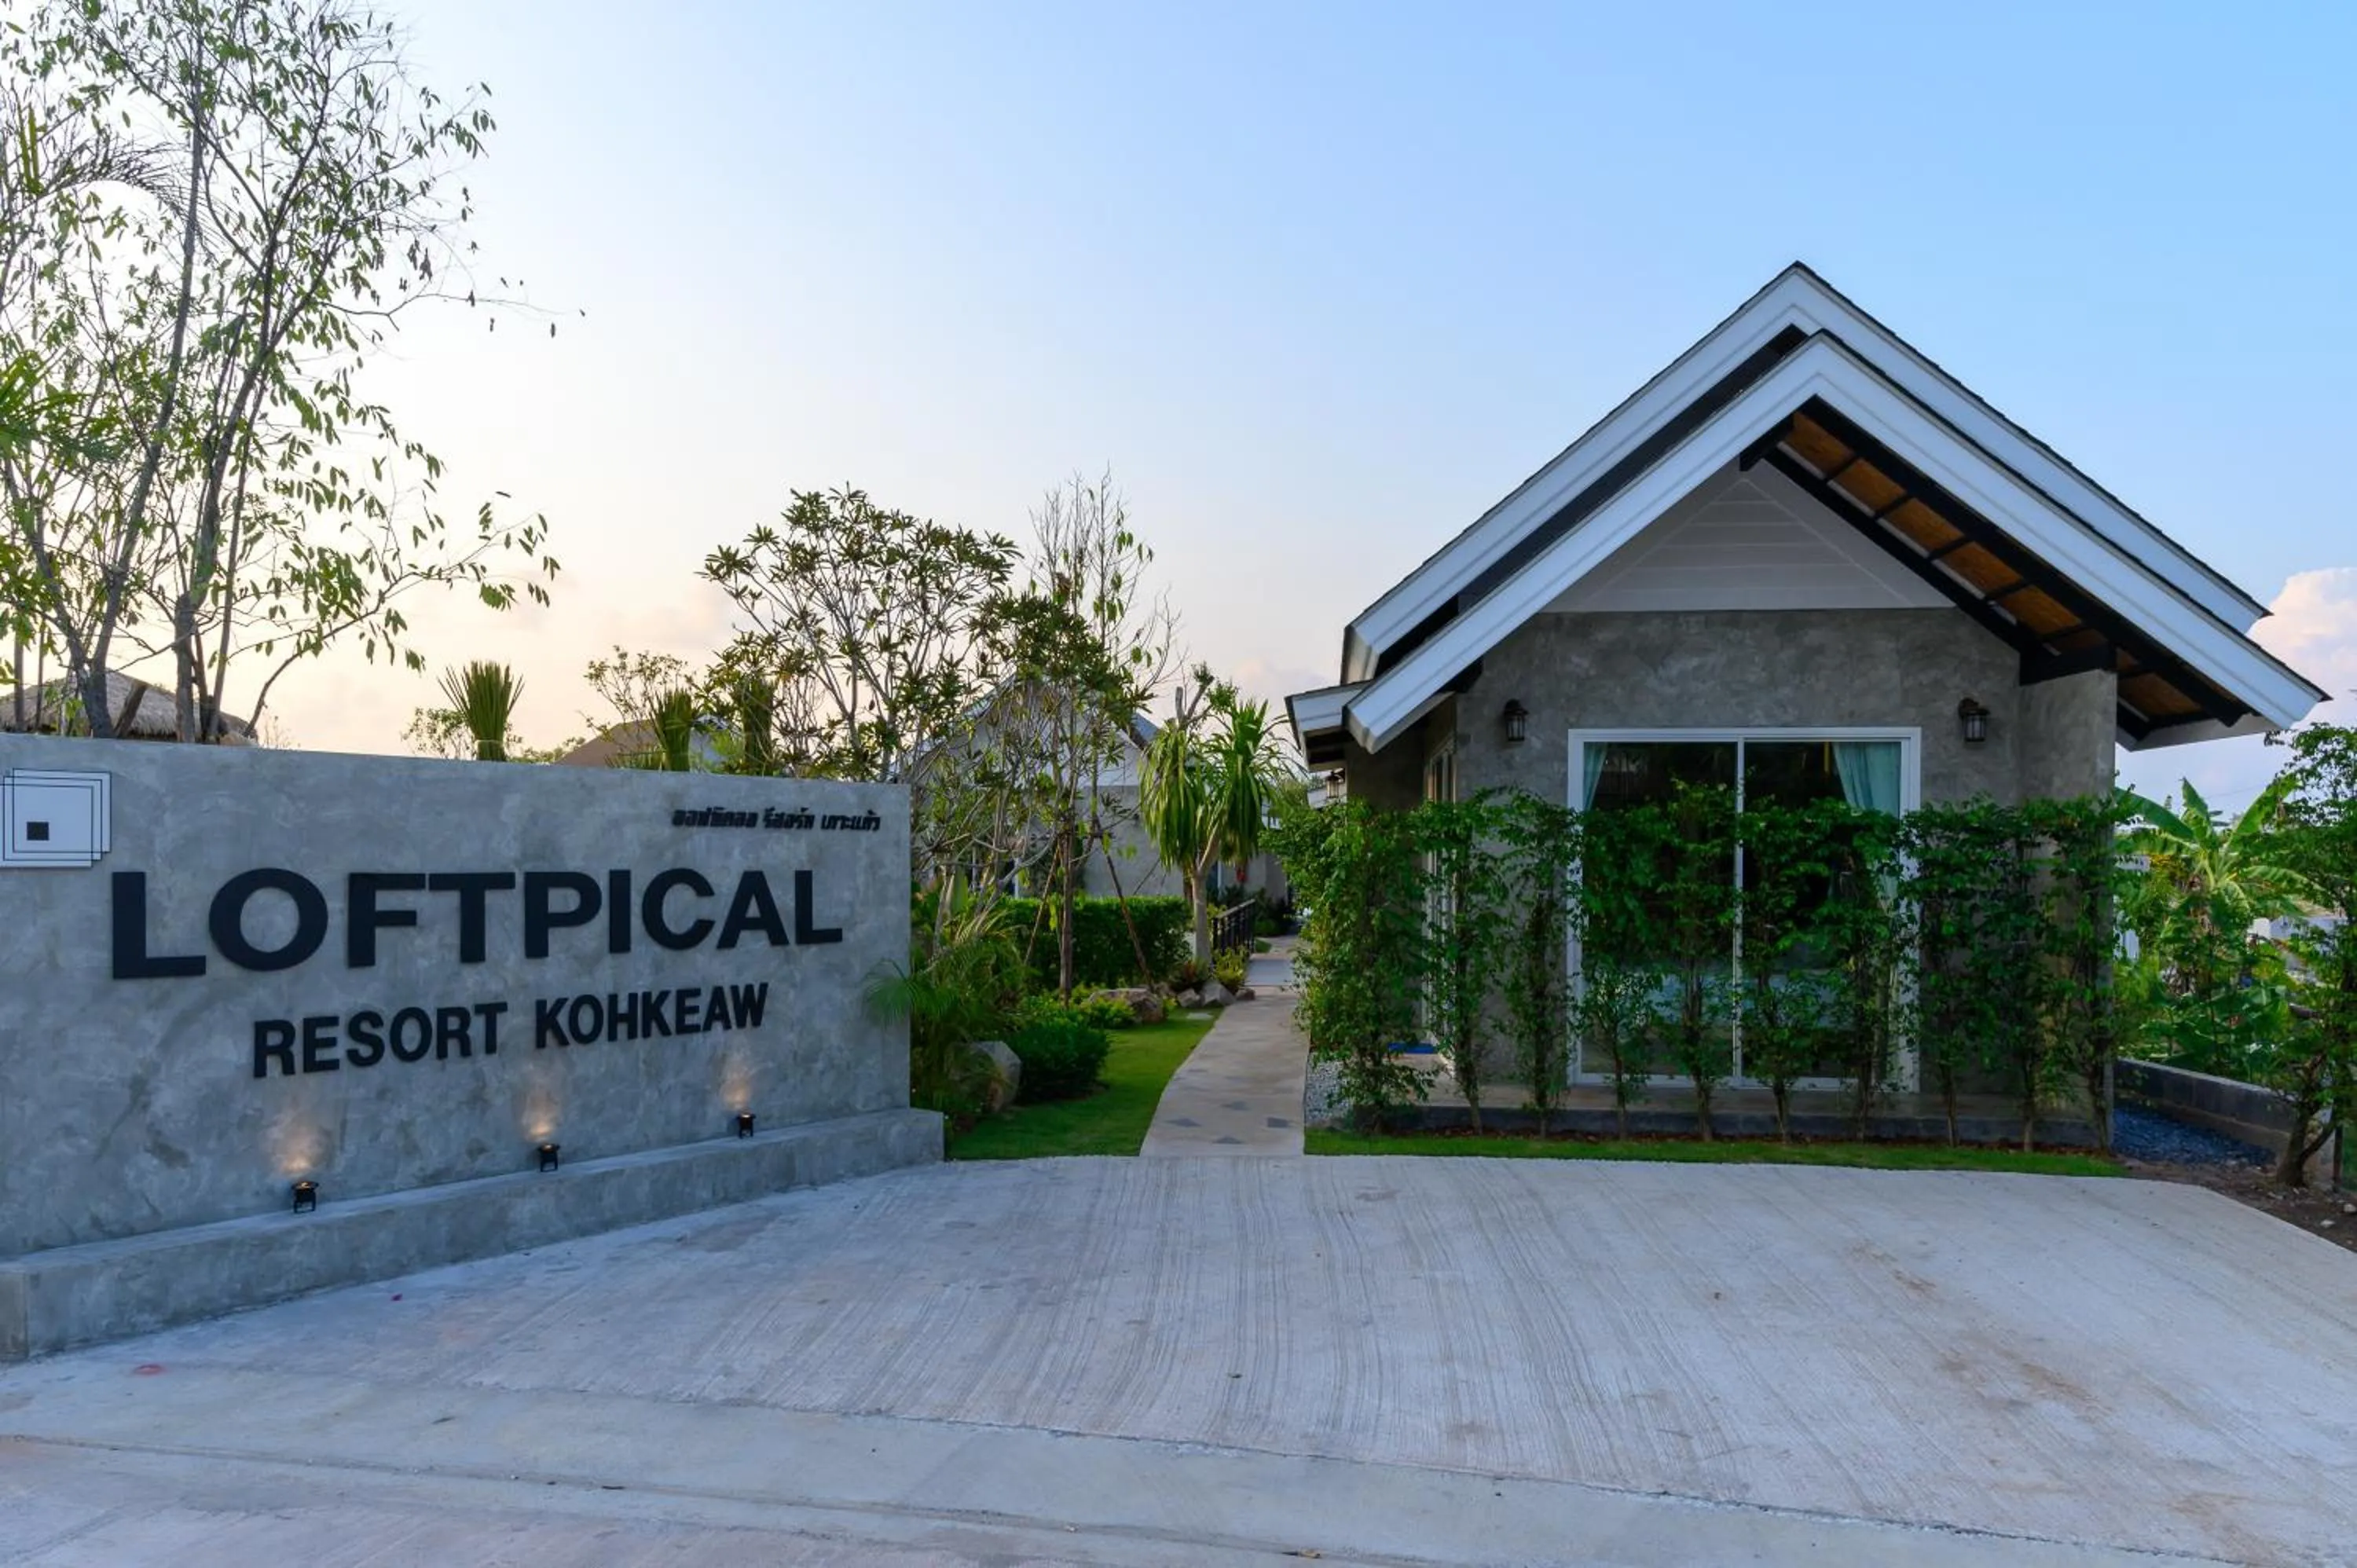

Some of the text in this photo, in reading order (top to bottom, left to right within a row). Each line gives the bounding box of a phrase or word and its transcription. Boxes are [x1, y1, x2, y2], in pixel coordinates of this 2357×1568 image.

[112, 867, 843, 980] LOFTPICAL
[253, 982, 768, 1079] RESORT KOHKEAW
